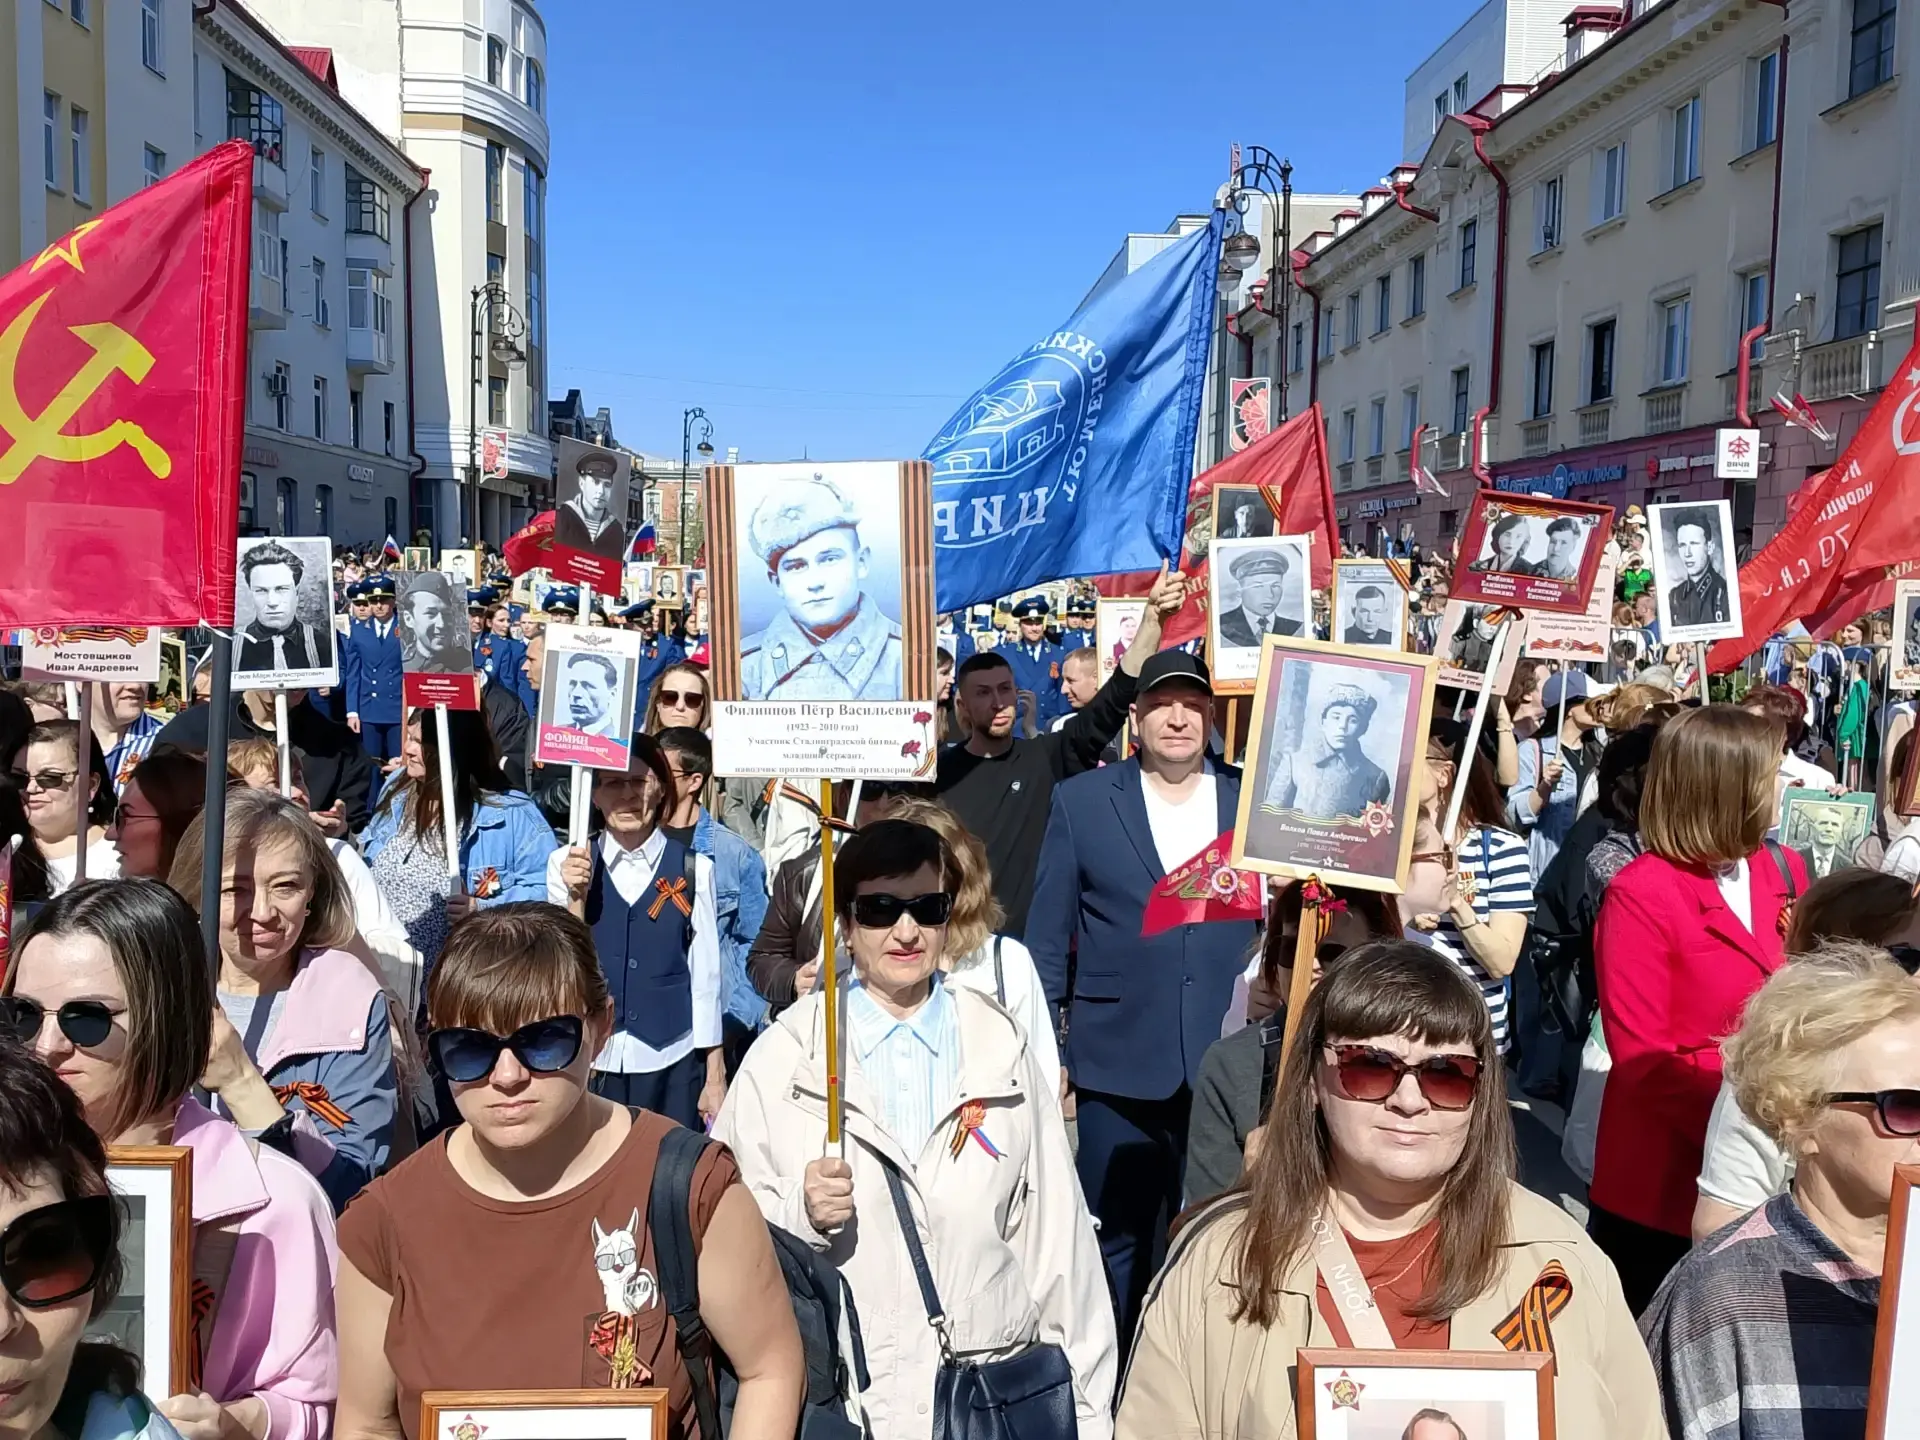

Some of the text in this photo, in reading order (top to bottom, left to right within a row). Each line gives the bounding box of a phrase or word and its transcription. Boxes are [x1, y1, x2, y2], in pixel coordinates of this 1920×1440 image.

[54, 651, 132, 661] Мостовщиков
[46, 663, 139, 673] Иван Андреевич
[725, 703, 921, 720] Филиппов Пётр Васильевич
[786, 723, 809, 732] (1923
[819, 723, 839, 732] 2010
[841, 723, 859, 732] год)
[544, 732, 589, 745] ФОМИН
[748, 737, 900, 748] Участник Сталинградской битвы,
[782, 752, 865, 761] младший сержант,
[779, 766, 855, 775] противотанковой
[1331, 1263, 1369, 1320] JOHN
